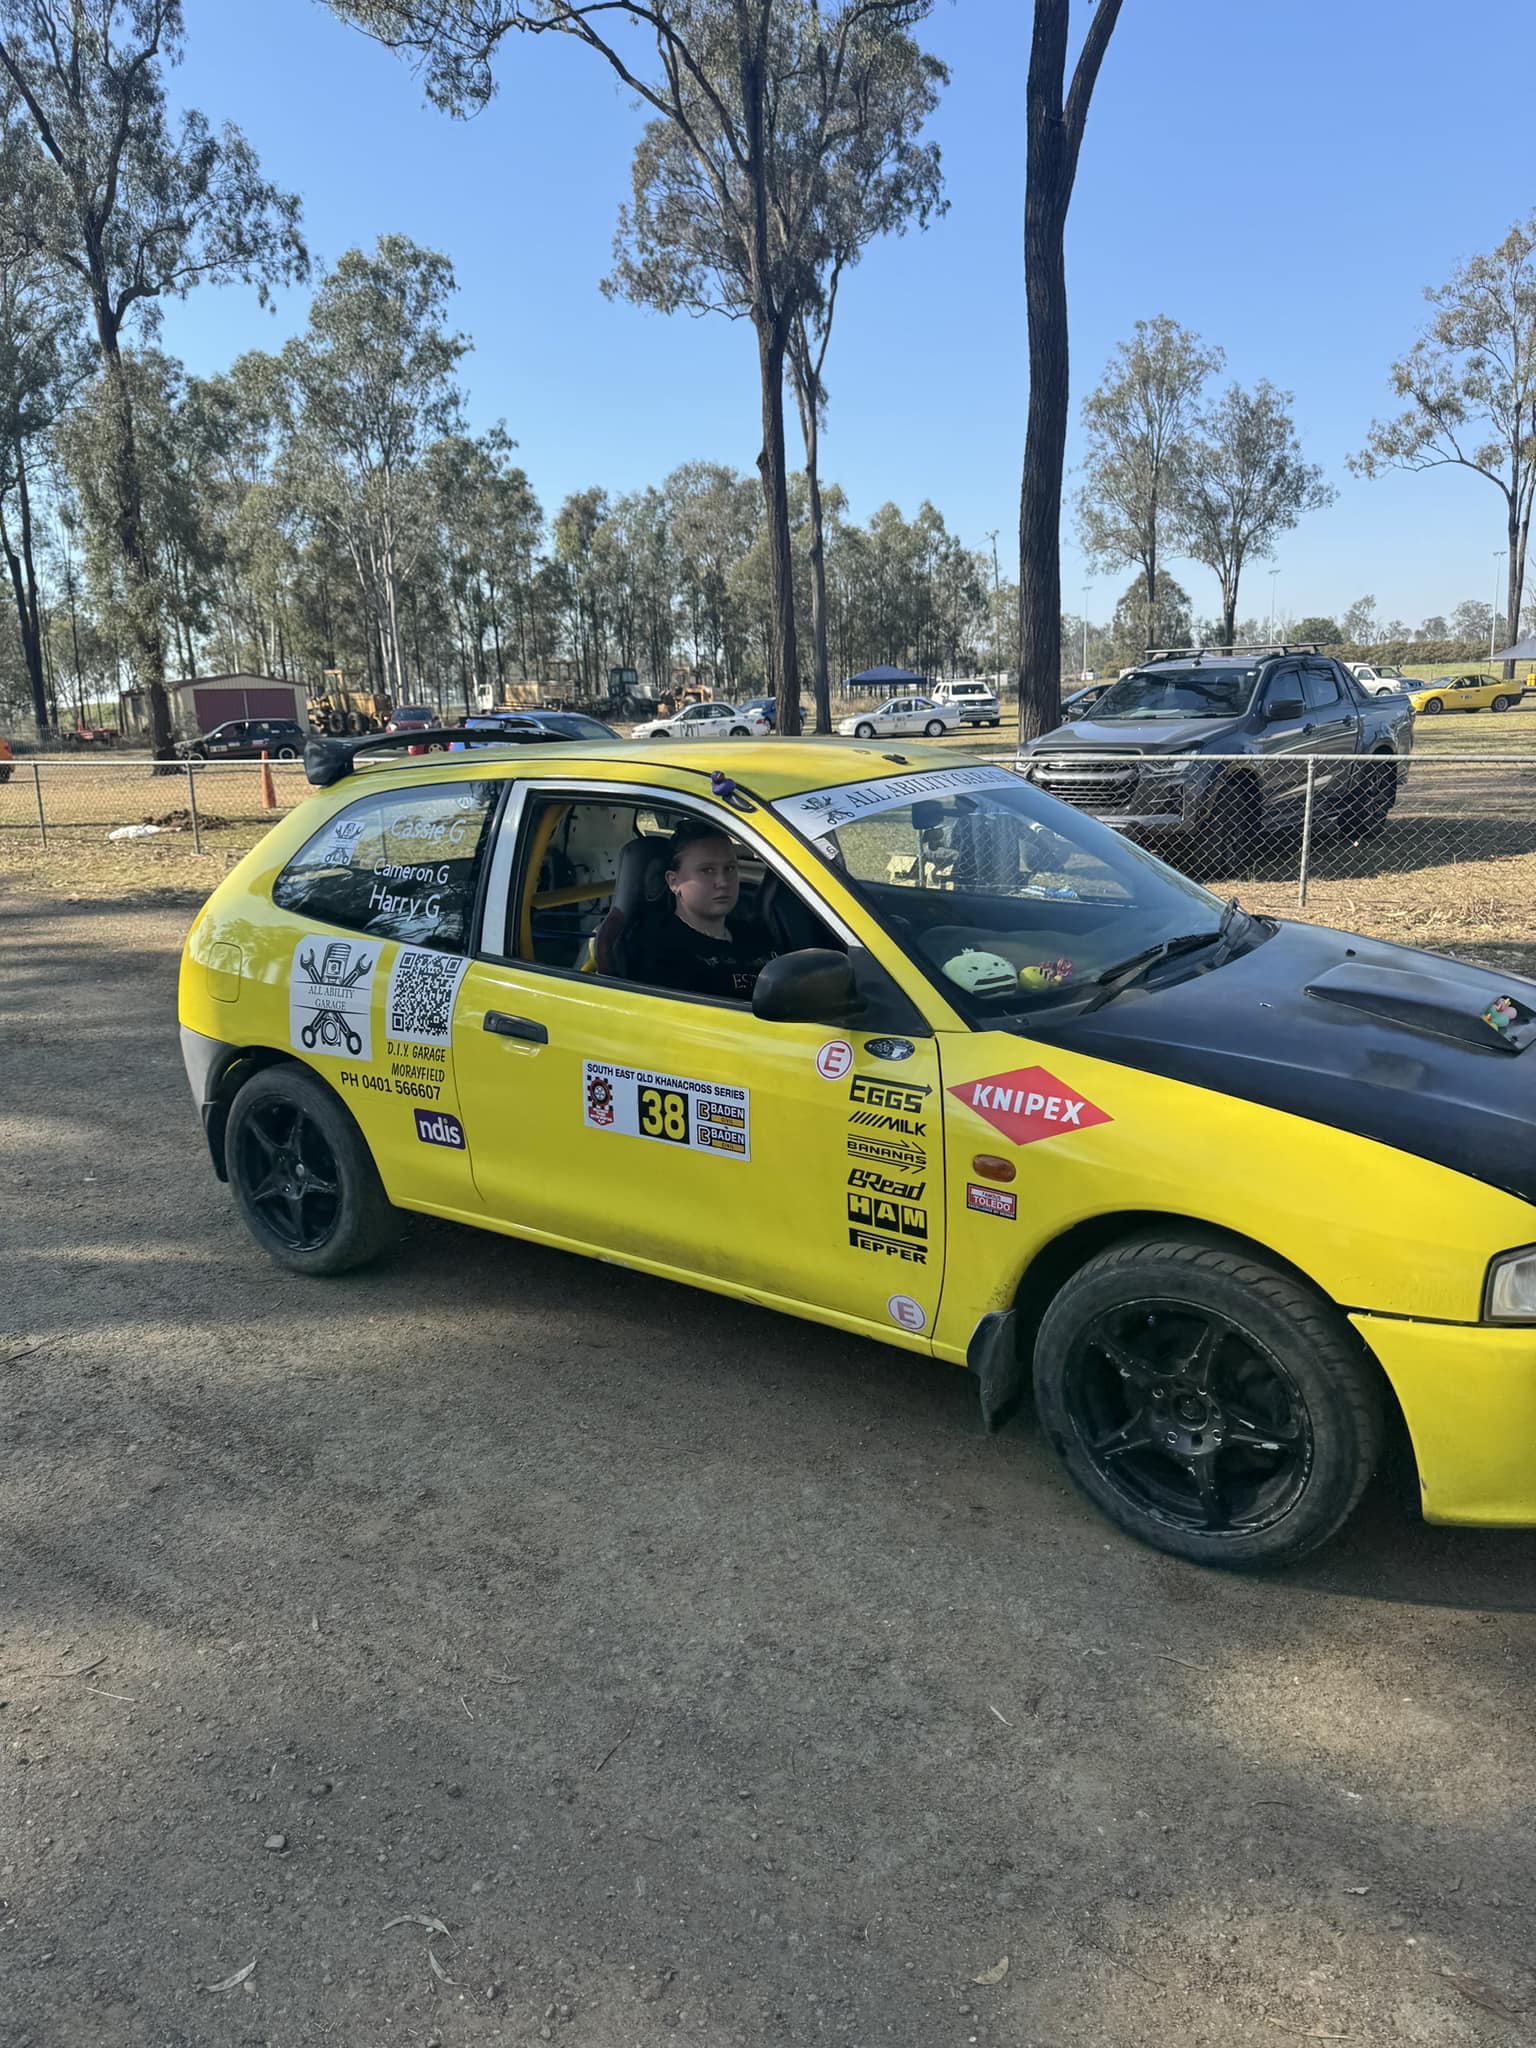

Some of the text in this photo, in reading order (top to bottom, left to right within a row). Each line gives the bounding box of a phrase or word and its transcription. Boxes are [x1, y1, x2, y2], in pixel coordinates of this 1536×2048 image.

[845, 787, 892, 808] ALL
[887, 773, 957, 800] ABILITY
[391, 815, 467, 844] Cassie G
[374, 858, 450, 885] Cameron G
[368, 884, 441, 922] Harry G
[308, 985, 354, 999] ALL ABILITY
[314, 999, 346, 1011] GARAGE
[387, 1041, 446, 1063] D.I.Y. GARAGE
[823, 1046, 846, 1073] E
[340, 1071, 441, 1100] PH 0401 566607
[391, 1063, 445, 1083] MORAYFIELD
[587, 1063, 745, 1101] SOUTH EAST QLD KHANACROSS SERIES
[849, 1074, 924, 1114] EGGS
[972, 1083, 1085, 1126] KNIPEX
[642, 1089, 686, 1141] 38
[710, 1103, 744, 1120] BADEN
[419, 1117, 460, 1145] ndis
[711, 1128, 745, 1145] BADEN
[848, 1140, 927, 1165] BANANAS
[849, 1194, 925, 1229] HAM
[974, 1196, 1010, 1212] TOLEDO
[848, 1228, 928, 1265] PEPPER
[896, 1301, 916, 1325] E
